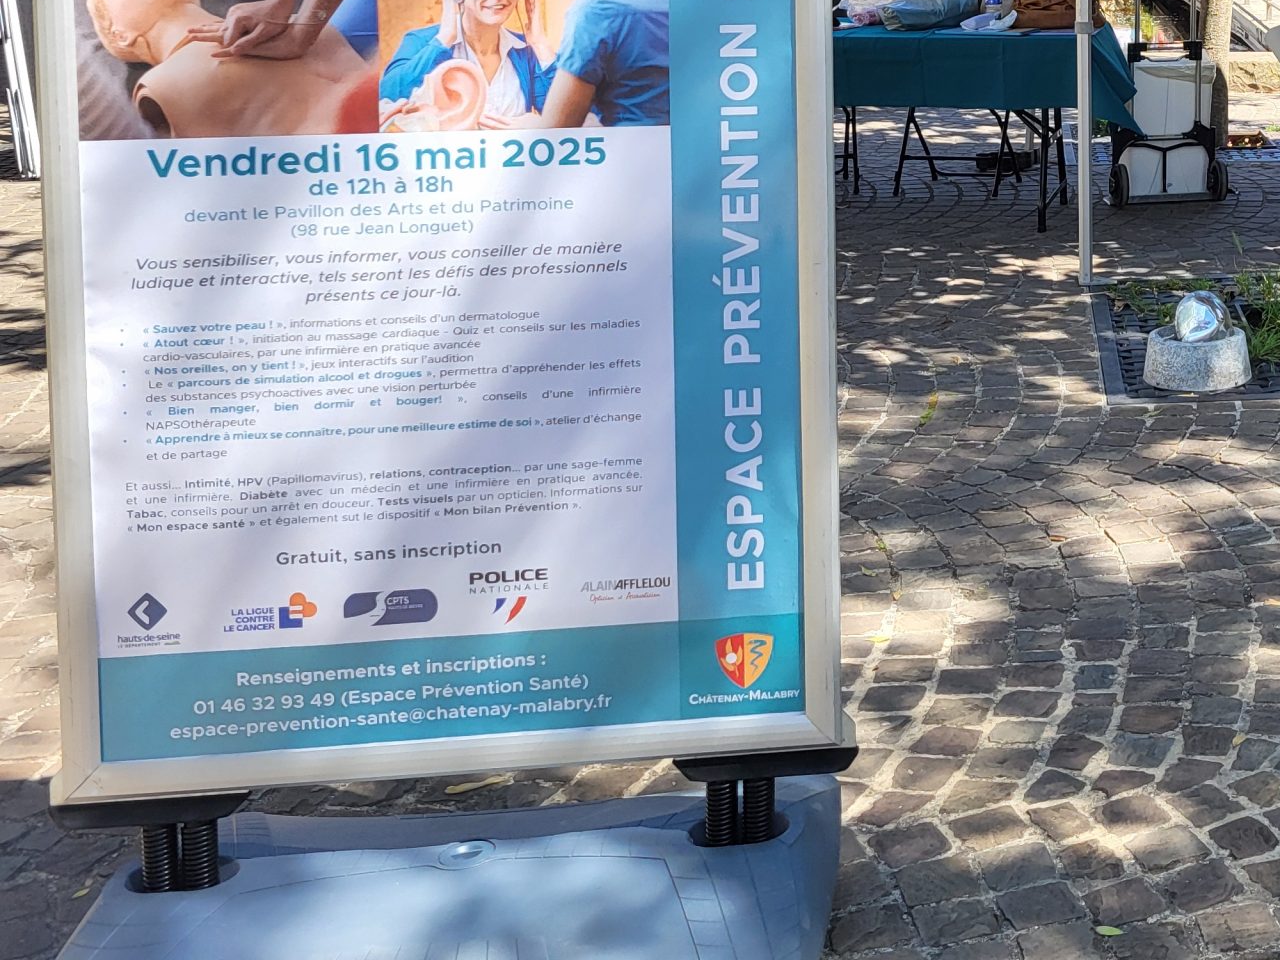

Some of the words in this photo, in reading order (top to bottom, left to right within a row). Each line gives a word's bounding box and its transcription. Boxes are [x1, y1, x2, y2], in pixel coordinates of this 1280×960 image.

[146, 142, 340, 178] Vendredi
[355, 142, 399, 172] 16
[415, 138, 486, 170] mai
[502, 136, 606, 167] 2025
[308, 178, 338, 196] de
[346, 177, 386, 194] 12h
[394, 176, 406, 194] à
[414, 175, 452, 192] 18h
[712, 23, 761, 365] PRÉVENTION
[184, 208, 247, 222] devant
[252, 206, 269, 220] le
[274, 204, 344, 218] Pavillon
[350, 203, 382, 216] des
[387, 202, 423, 215] Arts
[428, 201, 446, 214] et
[451, 200, 474, 214] du
[480, 196, 574, 212] Patrimoine
[290, 223, 318, 238] (98
[323, 225, 350, 236] rue
[354, 222, 394, 235] Jean
[399, 219, 474, 235] Longuet)
[136, 258, 177, 270] Vous
[182, 253, 278, 268] sensibiliser,
[285, 253, 324, 264] vous
[327, 250, 401, 263] informer,
[407, 249, 447, 260] vous
[450, 244, 528, 259] conseiller
[532, 243, 552, 256] de
[556, 241, 622, 254] manière
[131, 276, 194, 290] ludique
[198, 274, 215, 287] et
[220, 271, 312, 286] interactive,
[318, 270, 346, 282] tels
[350, 268, 403, 282] seront
[408, 267, 430, 279] les
[434, 264, 474, 278] défis
[478, 264, 507, 276] des
[511, 259, 627, 278] professionnels
[304, 289, 375, 304] présents
[380, 289, 399, 300] ce
[401, 284, 460, 302] jour-là.
[142, 350, 254, 362] cardio-vasculaires,
[256, 349, 277, 359] par
[280, 348, 302, 356] une
[304, 345, 360, 355] infirmière
[362, 344, 378, 353] en
[381, 341, 430, 354] pratique
[432, 339, 480, 350] avancée
[145, 393, 167, 402] des
[170, 391, 237, 402] substances
[240, 387, 323, 400] psychoactives
[325, 387, 354, 395] avec
[357, 385, 379, 394] une
[382, 382, 415, 392] vision
[418, 379, 476, 393] perturbée
[146, 452, 158, 460] et
[161, 451, 177, 460] de
[180, 449, 227, 461] partage
[724, 386, 765, 590] ESPACE
[276, 548, 347, 565] Gratuit,
[354, 548, 396, 561] sans
[402, 540, 501, 558] inscription
[469, 568, 548, 584] POLICE
[470, 583, 549, 594] NATIONALE
[232, 608, 244, 616] LA
[246, 607, 274, 616] LIGUE
[236, 615, 274, 624] CONTRE
[236, 623, 275, 632] CANCER
[236, 663, 396, 686] Renseignements
[401, 660, 420, 675] et
[426, 654, 536, 674] inscriptions
[540, 654, 546, 665] :
[193, 700, 214, 714] 01
[220, 697, 246, 712] 46
[251, 695, 275, 710] 32
[280, 694, 304, 709] 93
[310, 692, 334, 707] 49
[340, 689, 416, 707] (Espace
[421, 679, 523, 699] Prévention
[528, 673, 588, 691] Santé)
[170, 693, 612, 740] espace-prevention-sante@chatenay-malabry.fr
